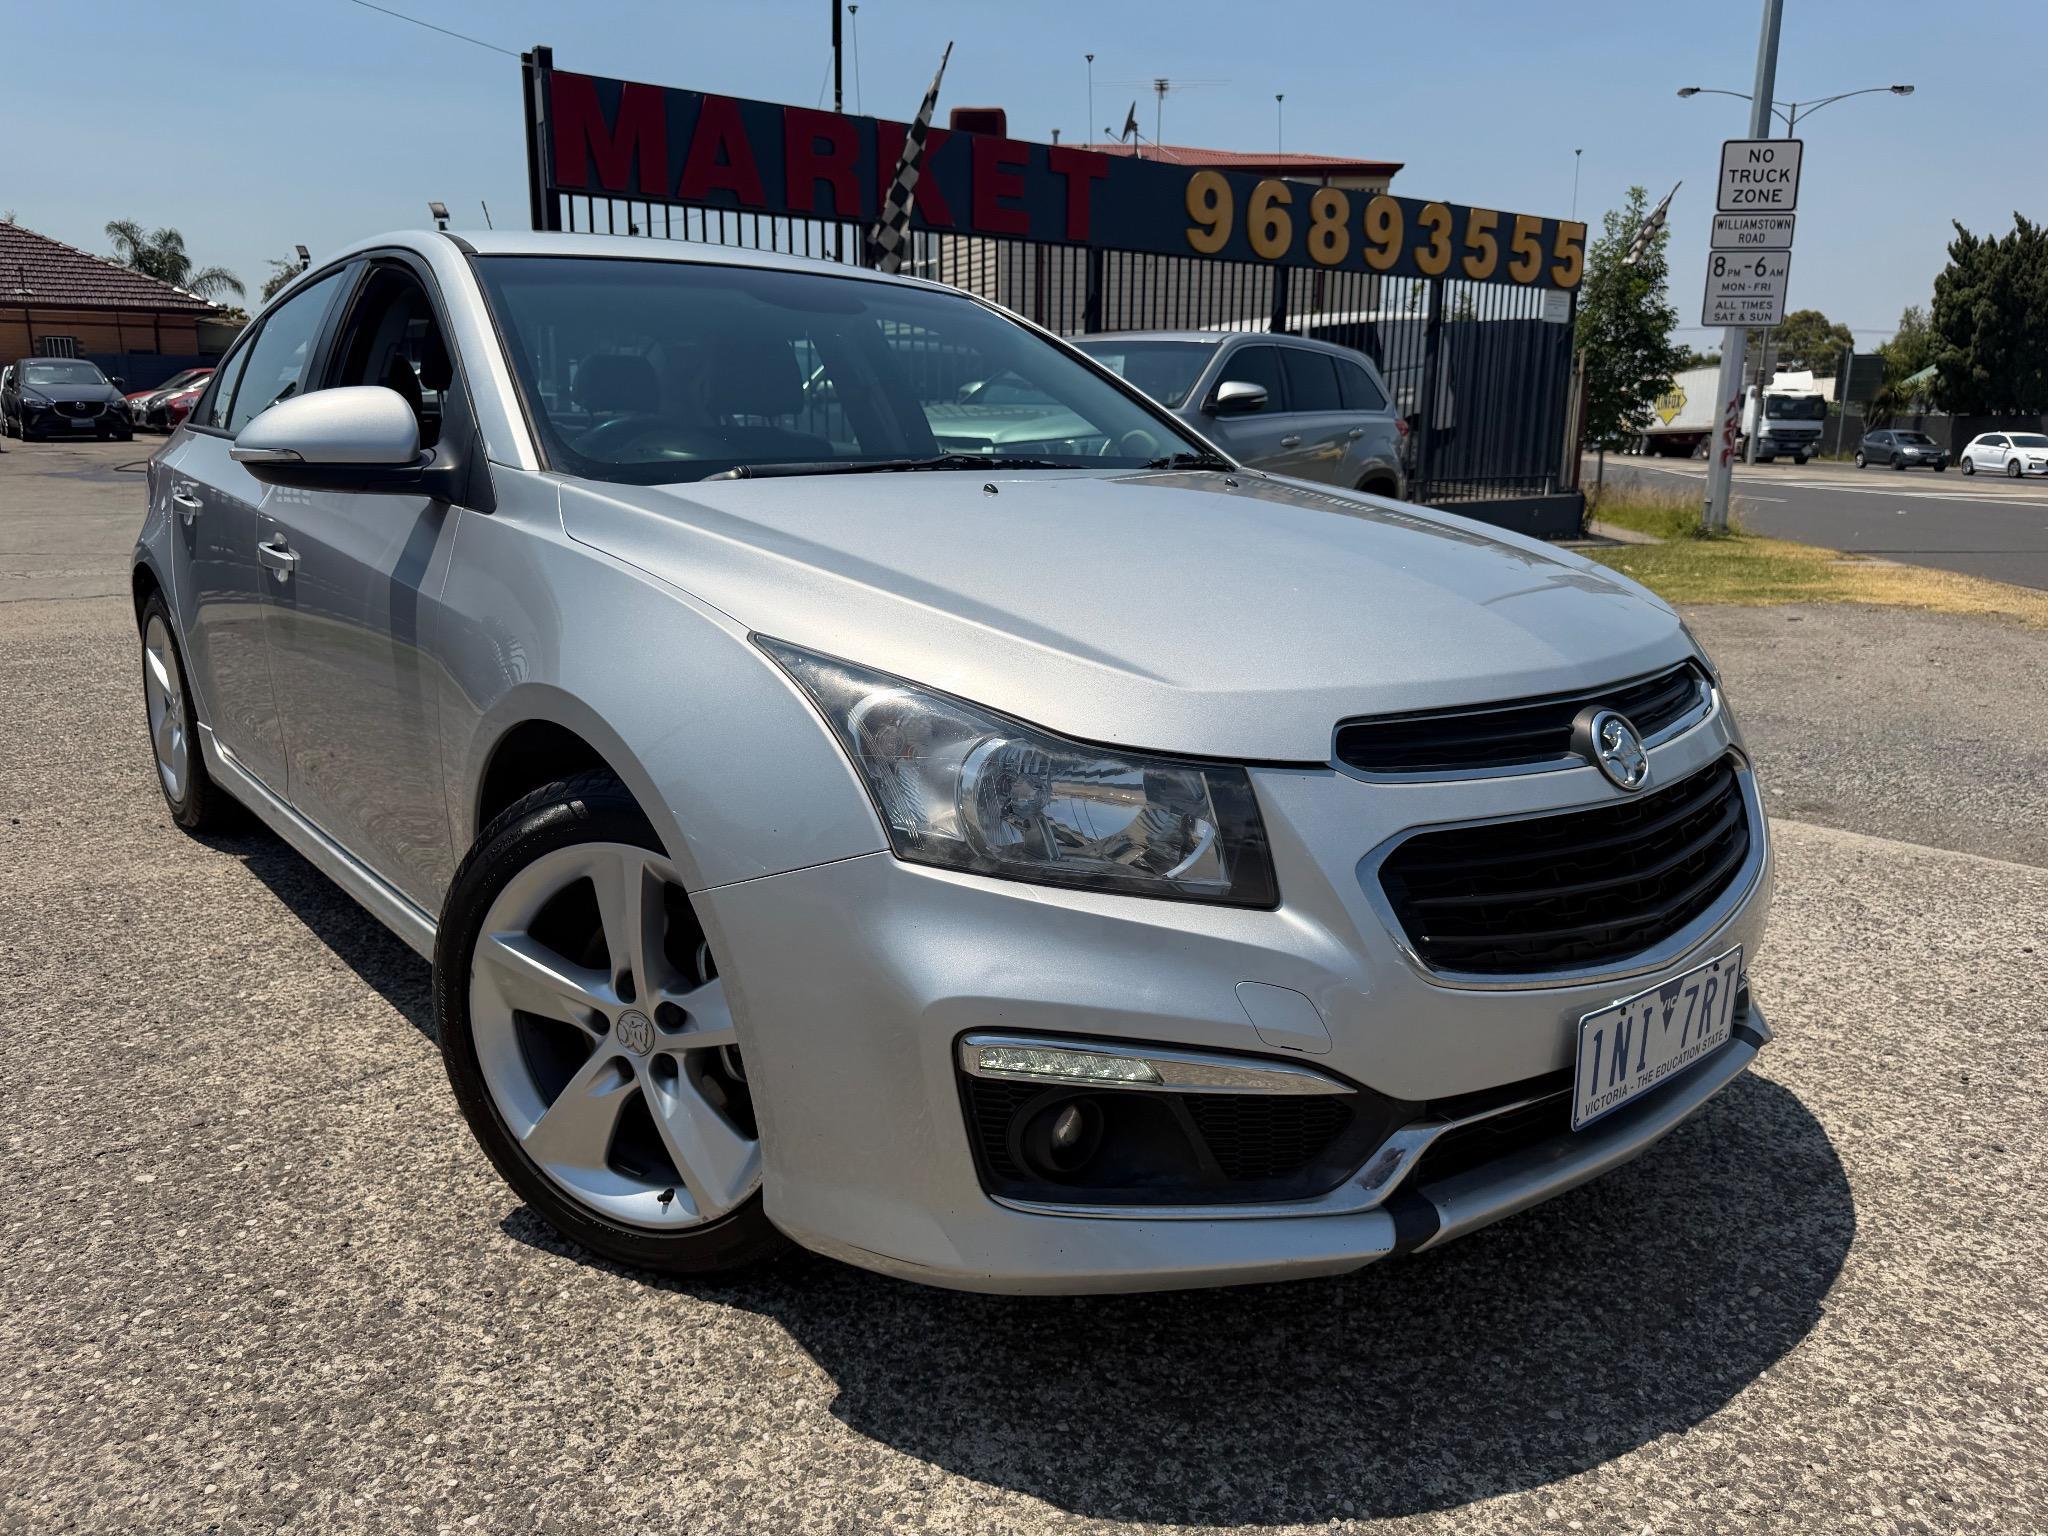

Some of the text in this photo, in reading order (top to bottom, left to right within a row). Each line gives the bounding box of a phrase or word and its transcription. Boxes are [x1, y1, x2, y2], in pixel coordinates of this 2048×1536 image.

[1748, 148, 1775, 164] NO
[549, 69, 1585, 289] MARKET 96893555
[1729, 168, 1791, 184] TRUCK
[1732, 188, 1784, 204] ZONE
[1716, 218, 1792, 231] WILLIAMSTOWN
[1738, 233, 1766, 244] ROAD
[1721, 282, 1745, 292] MON
[1753, 282, 1772, 292] FRI
[1715, 301, 1773, 311] ALL TIMES
[1714, 312, 1772, 322] SAT & SUN
[1584, 1083, 1628, 1117] VICTORIA
[1637, 1070, 1654, 1089] THE
[1655, 1044, 1701, 1079] EDUCATION
[1702, 1029, 1724, 1053] STATE
